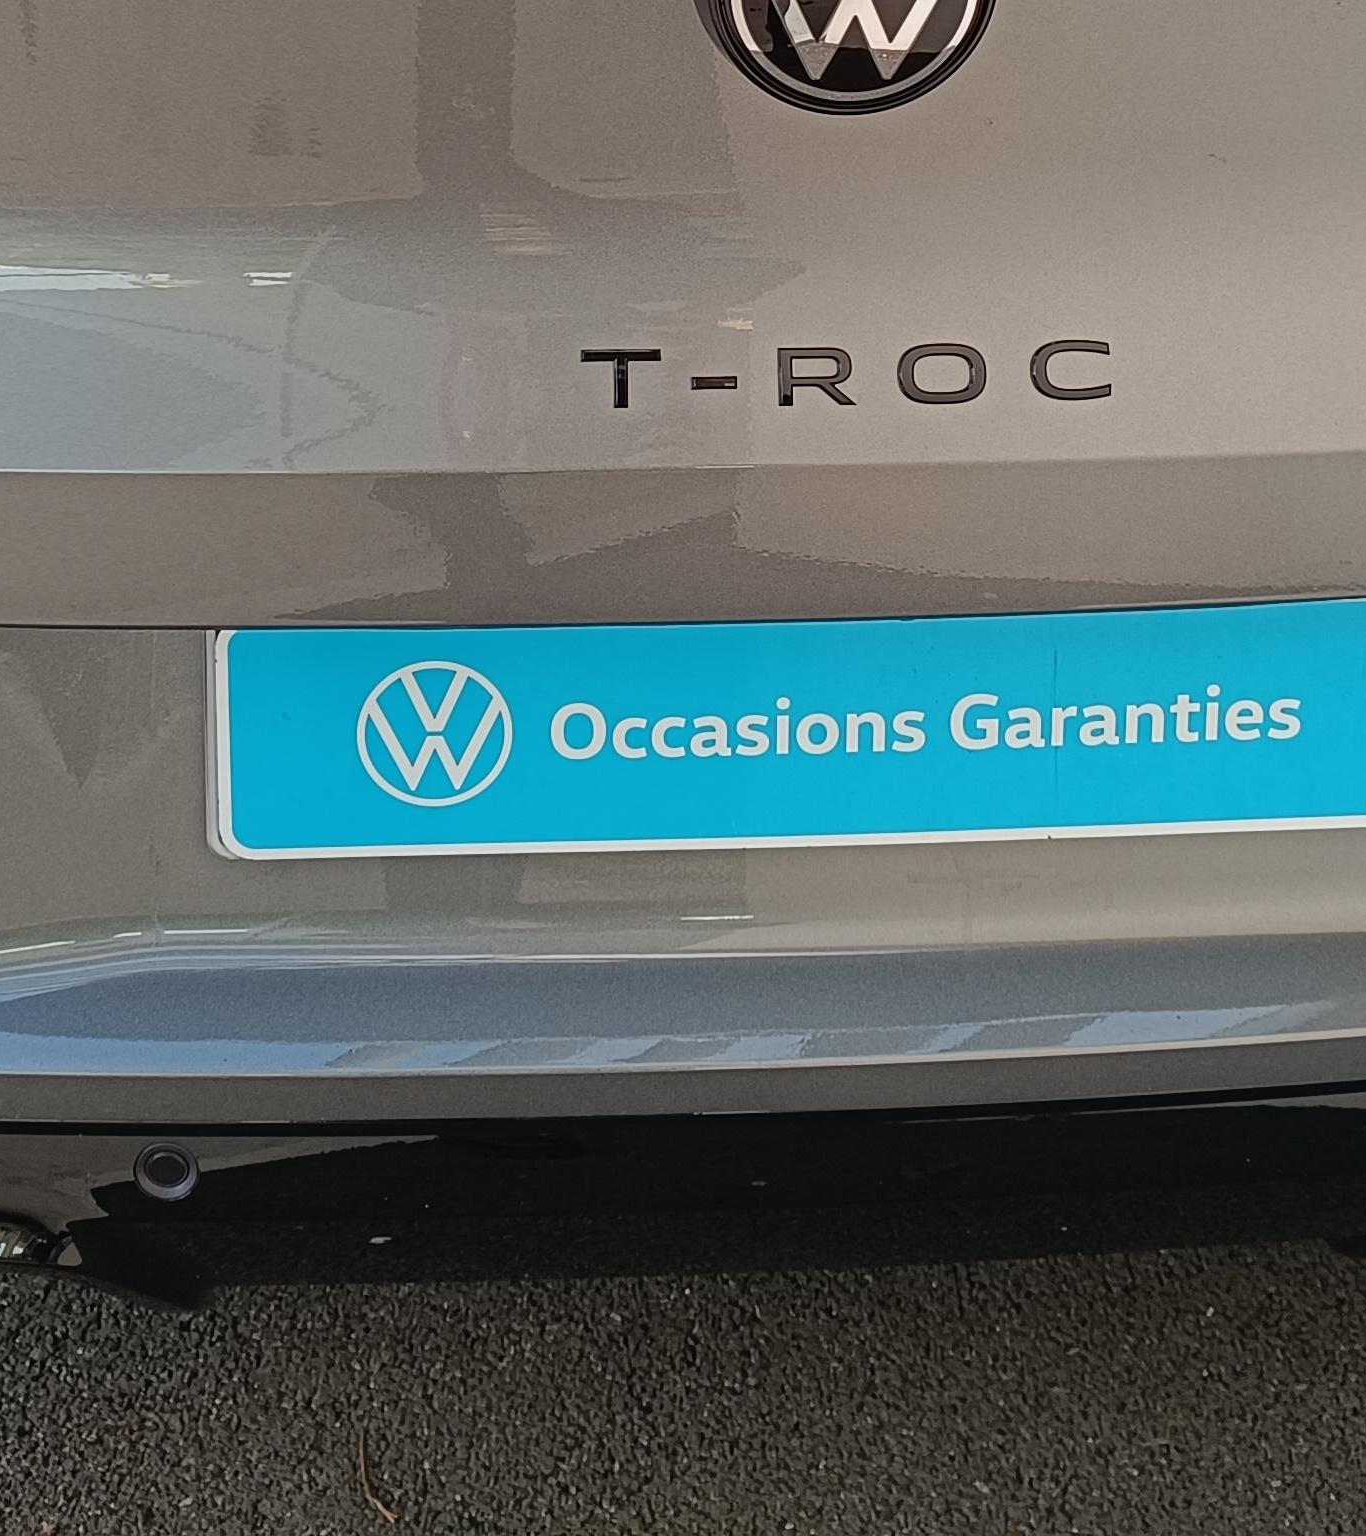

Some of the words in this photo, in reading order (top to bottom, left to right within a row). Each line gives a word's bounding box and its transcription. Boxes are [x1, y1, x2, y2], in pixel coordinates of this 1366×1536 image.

[580, 339, 1113, 410] T-ROC
[356, 660, 513, 807] VW
[549, 696, 926, 761] Occasions
[949, 684, 1303, 752] Garanties
